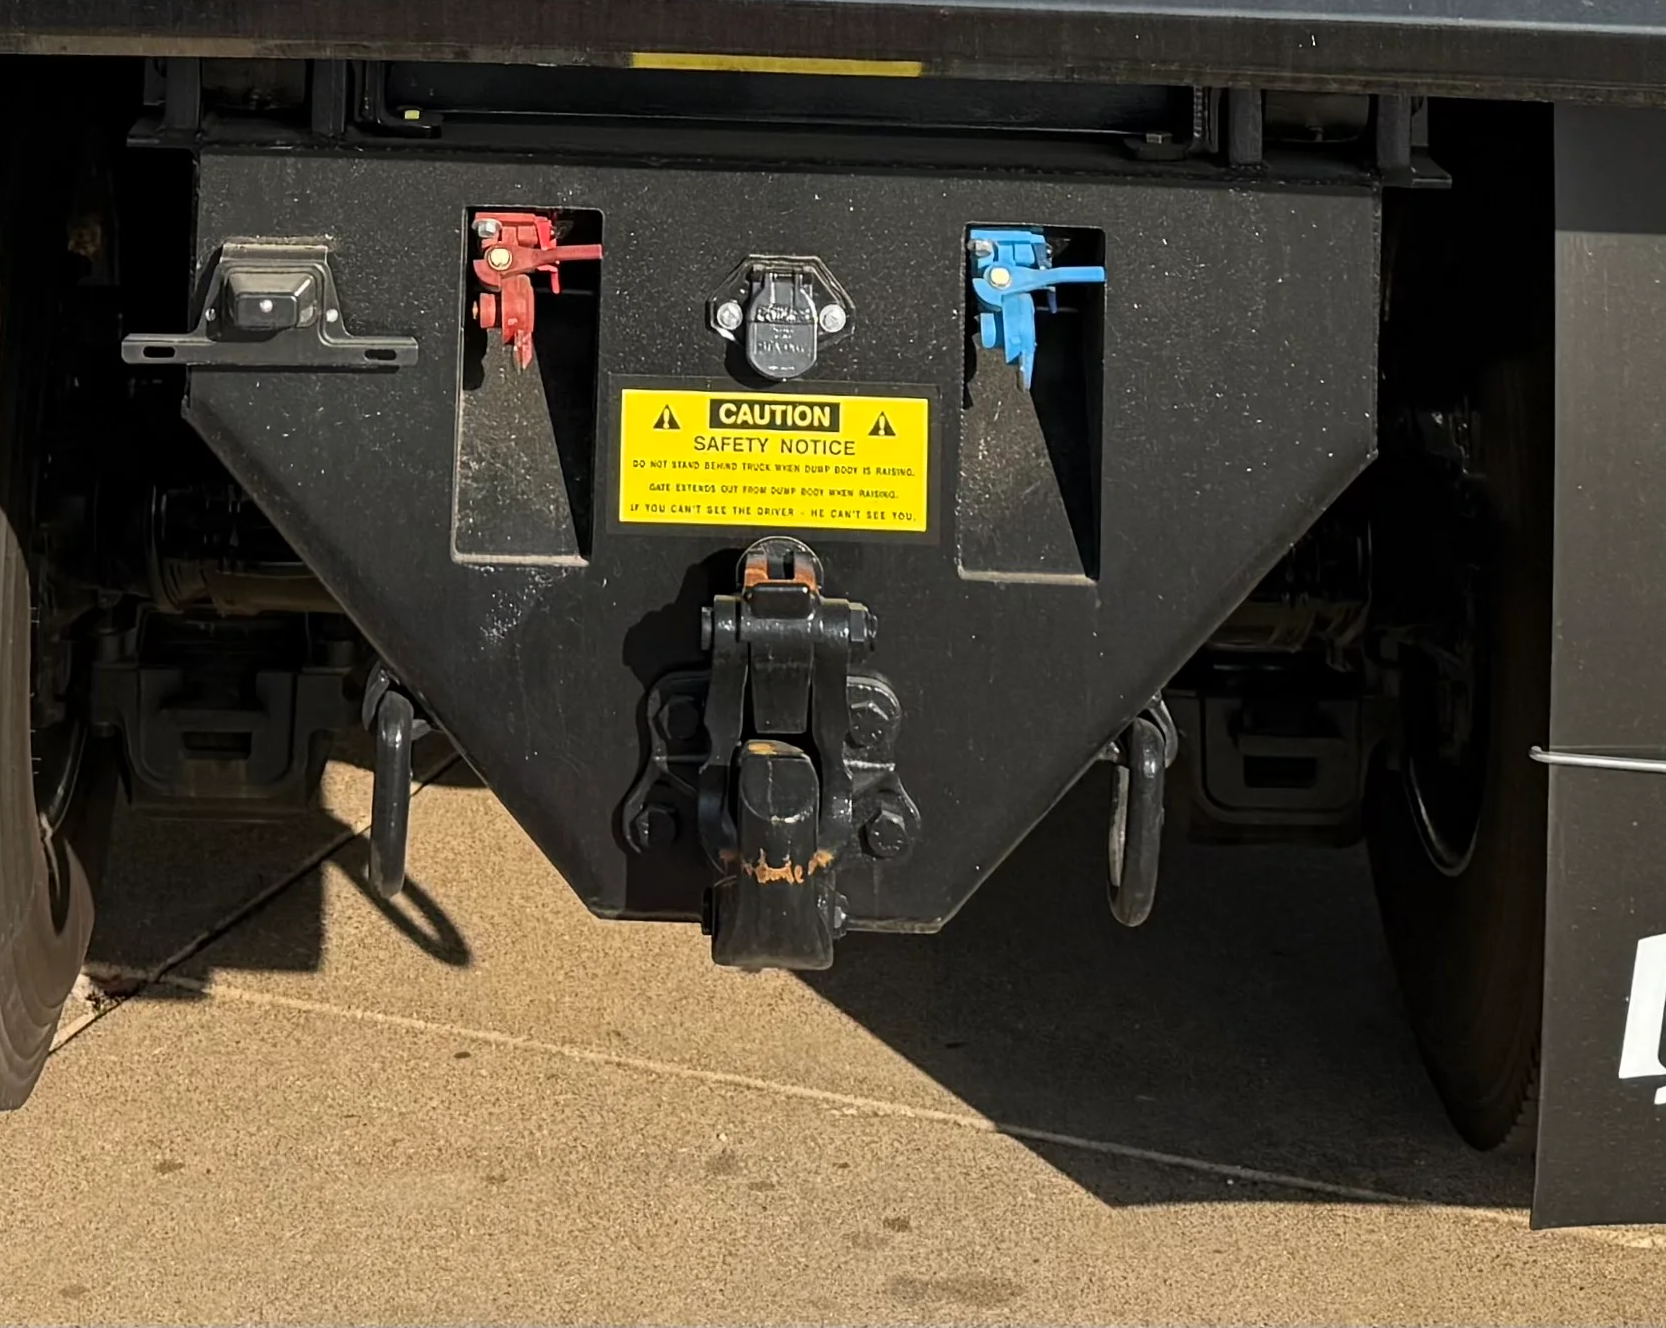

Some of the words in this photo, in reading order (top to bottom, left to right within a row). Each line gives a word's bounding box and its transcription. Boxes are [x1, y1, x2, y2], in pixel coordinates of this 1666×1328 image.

[718, 402, 831, 428] CAUTION
[694, 435, 769, 453] SAFETY
[780, 438, 856, 456] NOTICE
[633, 460, 646, 468] DO
[650, 460, 667, 469] NOT
[672, 461, 700, 470] STAND
[704, 461, 737, 471] BEHIND
[742, 462, 771, 472] TRUCK
[775, 464, 800, 473] WHEN
[805, 465, 830, 473] DUMP
[834, 465, 857, 475] BODY
[863, 466, 871, 475] IS
[649, 483, 670, 492] GATE
[676, 483, 716, 493] EXTENDS
[721, 484, 738, 494] OUT
[742, 485, 766, 494] FROM
[771, 486, 796, 495] DUMP
[801, 487, 824, 496] BODY
[829, 488, 853, 497] WHEN
[630, 503, 639, 512] IF
[645, 504, 666, 513] YOU
[671, 504, 701, 514] CAN'T
[707, 505, 727, 515] SEE
[733, 506, 751, 515] THE
[757, 507, 794, 517] DRIVER
[811, 509, 824, 517] HE
[830, 509, 860, 519] CAN'T
[867, 510, 885, 520] SEE
